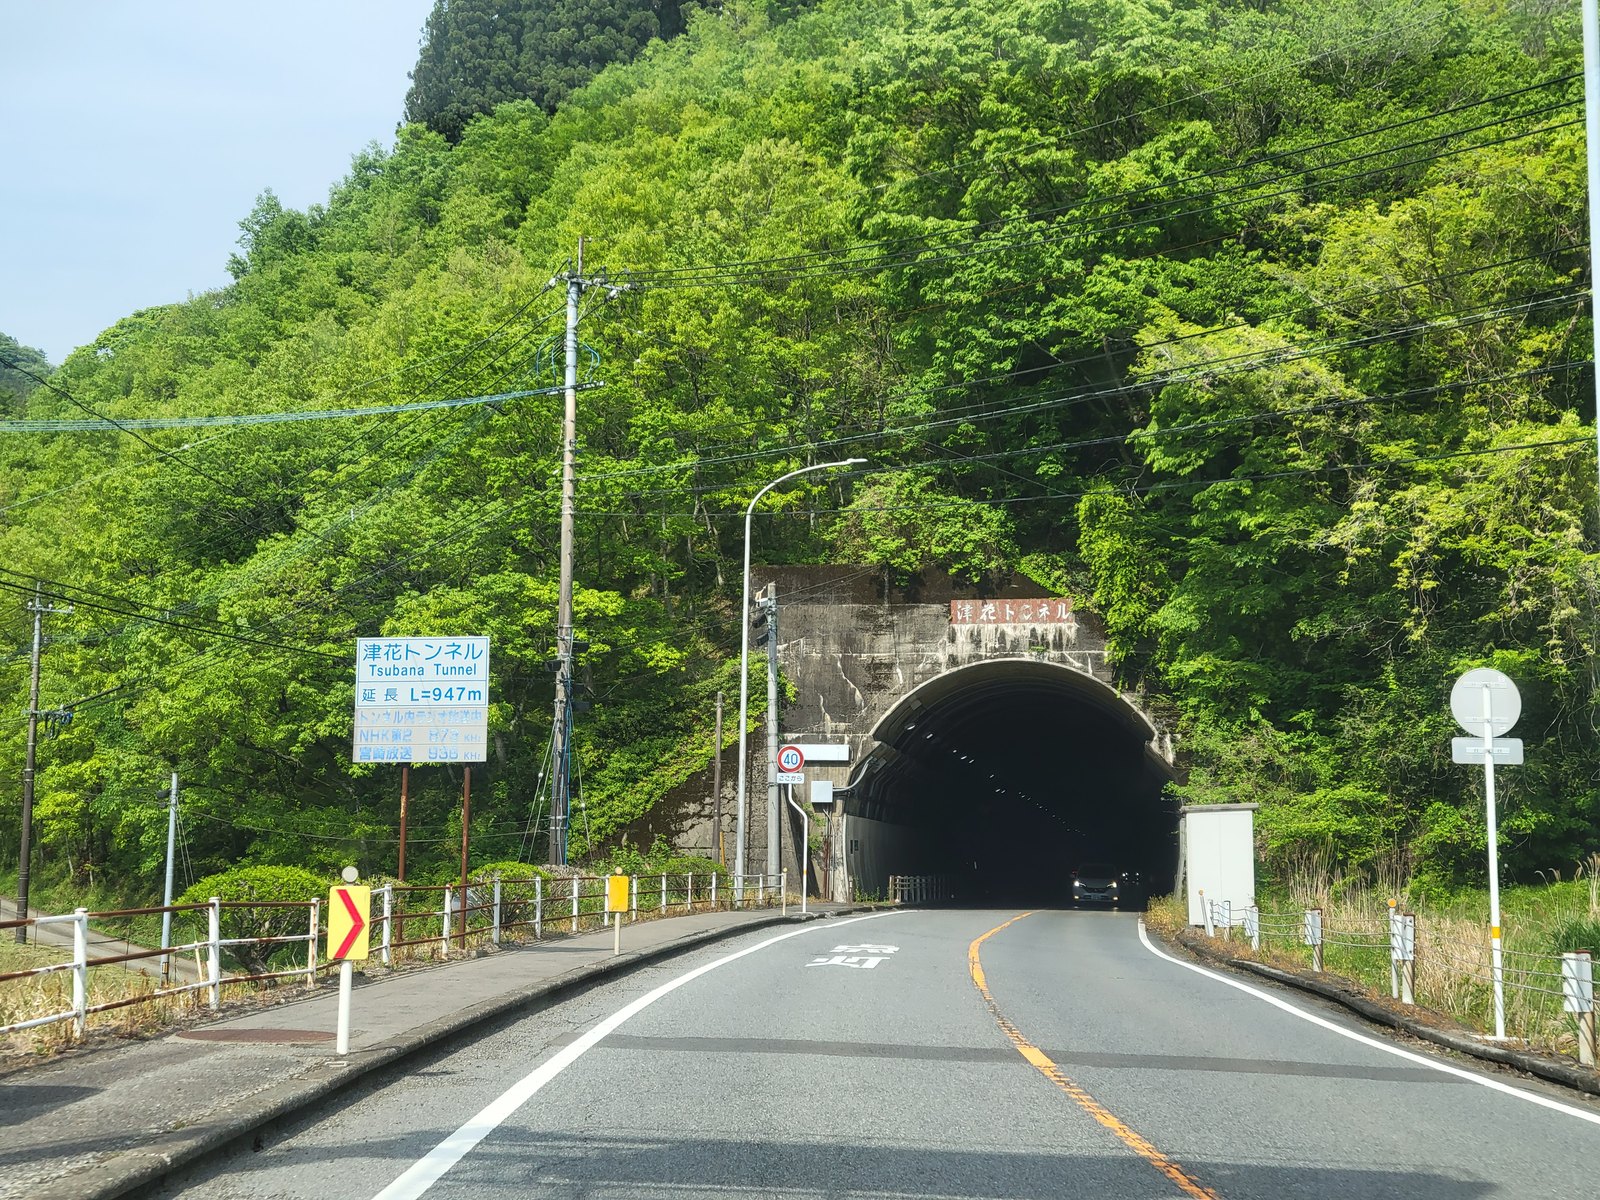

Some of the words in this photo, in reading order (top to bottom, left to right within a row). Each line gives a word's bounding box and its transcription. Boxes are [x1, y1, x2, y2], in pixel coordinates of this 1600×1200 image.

[957, 602, 1070, 621] 津花トンネル
[362, 642, 483, 661] 津花トンネル
[369, 664, 424, 676] Tsubana
[433, 663, 477, 675] Tunnel
[361, 687, 398, 702] 延長
[410, 687, 482, 701] L=947m
[783, 753, 798, 765] 40
